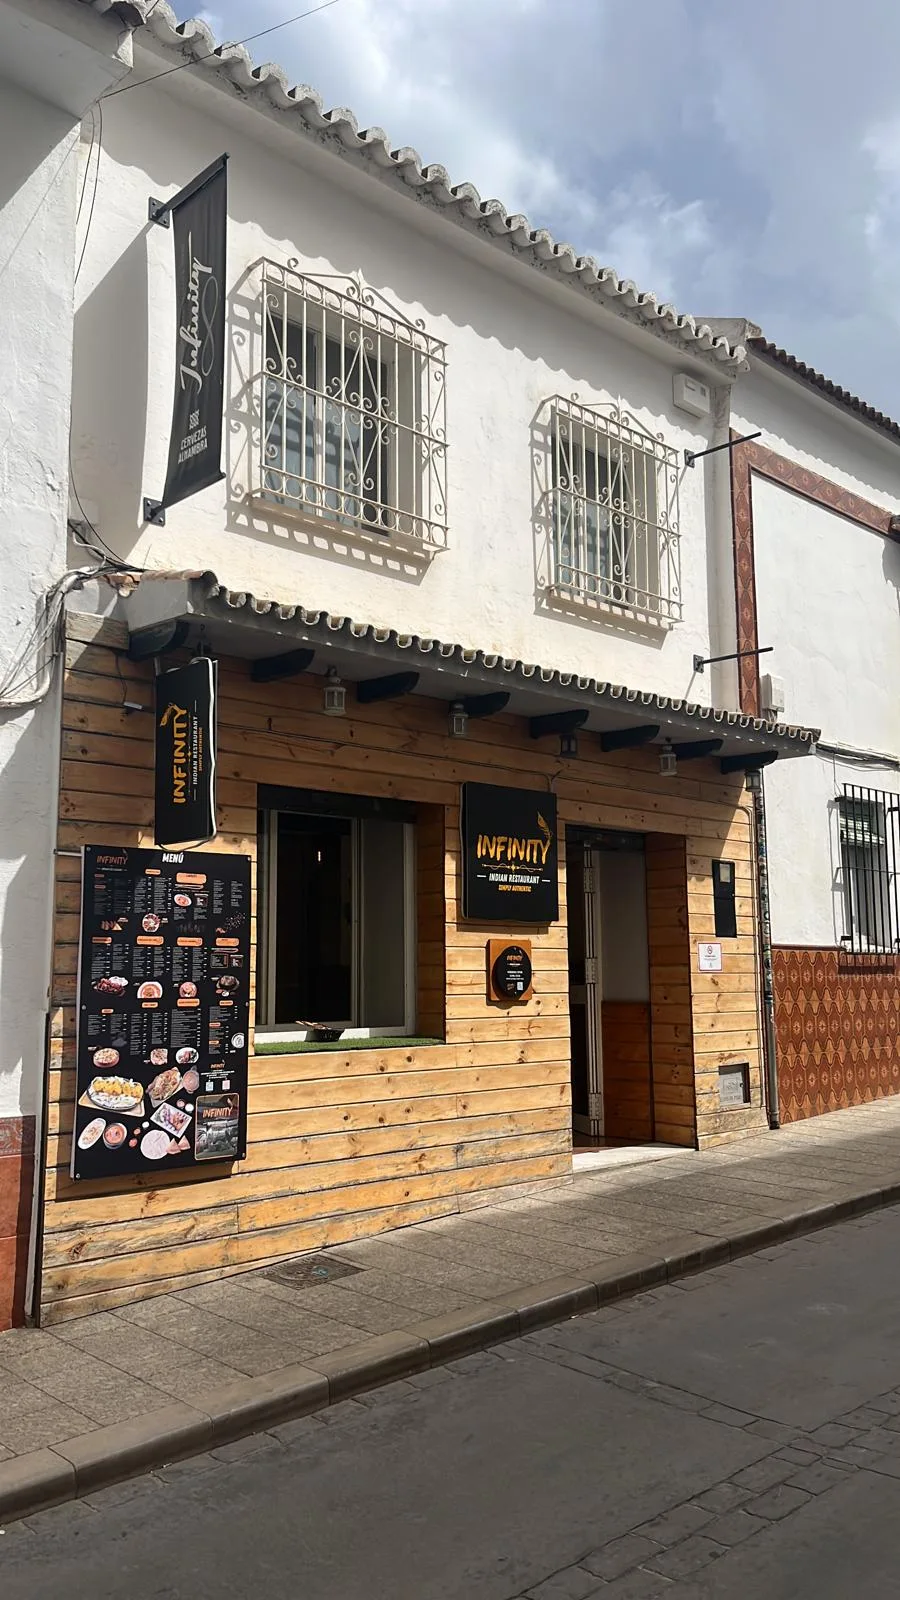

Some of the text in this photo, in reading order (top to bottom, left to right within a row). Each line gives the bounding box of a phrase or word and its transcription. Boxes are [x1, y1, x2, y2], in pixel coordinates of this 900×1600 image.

[179, 231, 213, 394] Infinity
[180, 425, 207, 450] CERVEZAS
[177, 438, 208, 464] ALHAMBRA
[173, 704, 187, 803] INFINITY
[96, 855, 128, 865] INFINITY
[162, 852, 184, 863] MENÚ
[476, 834, 551, 865] INFINITY
[488, 873, 540, 884] INDIAN RESTAURANT
[202, 1107, 233, 1118] INFINITY
